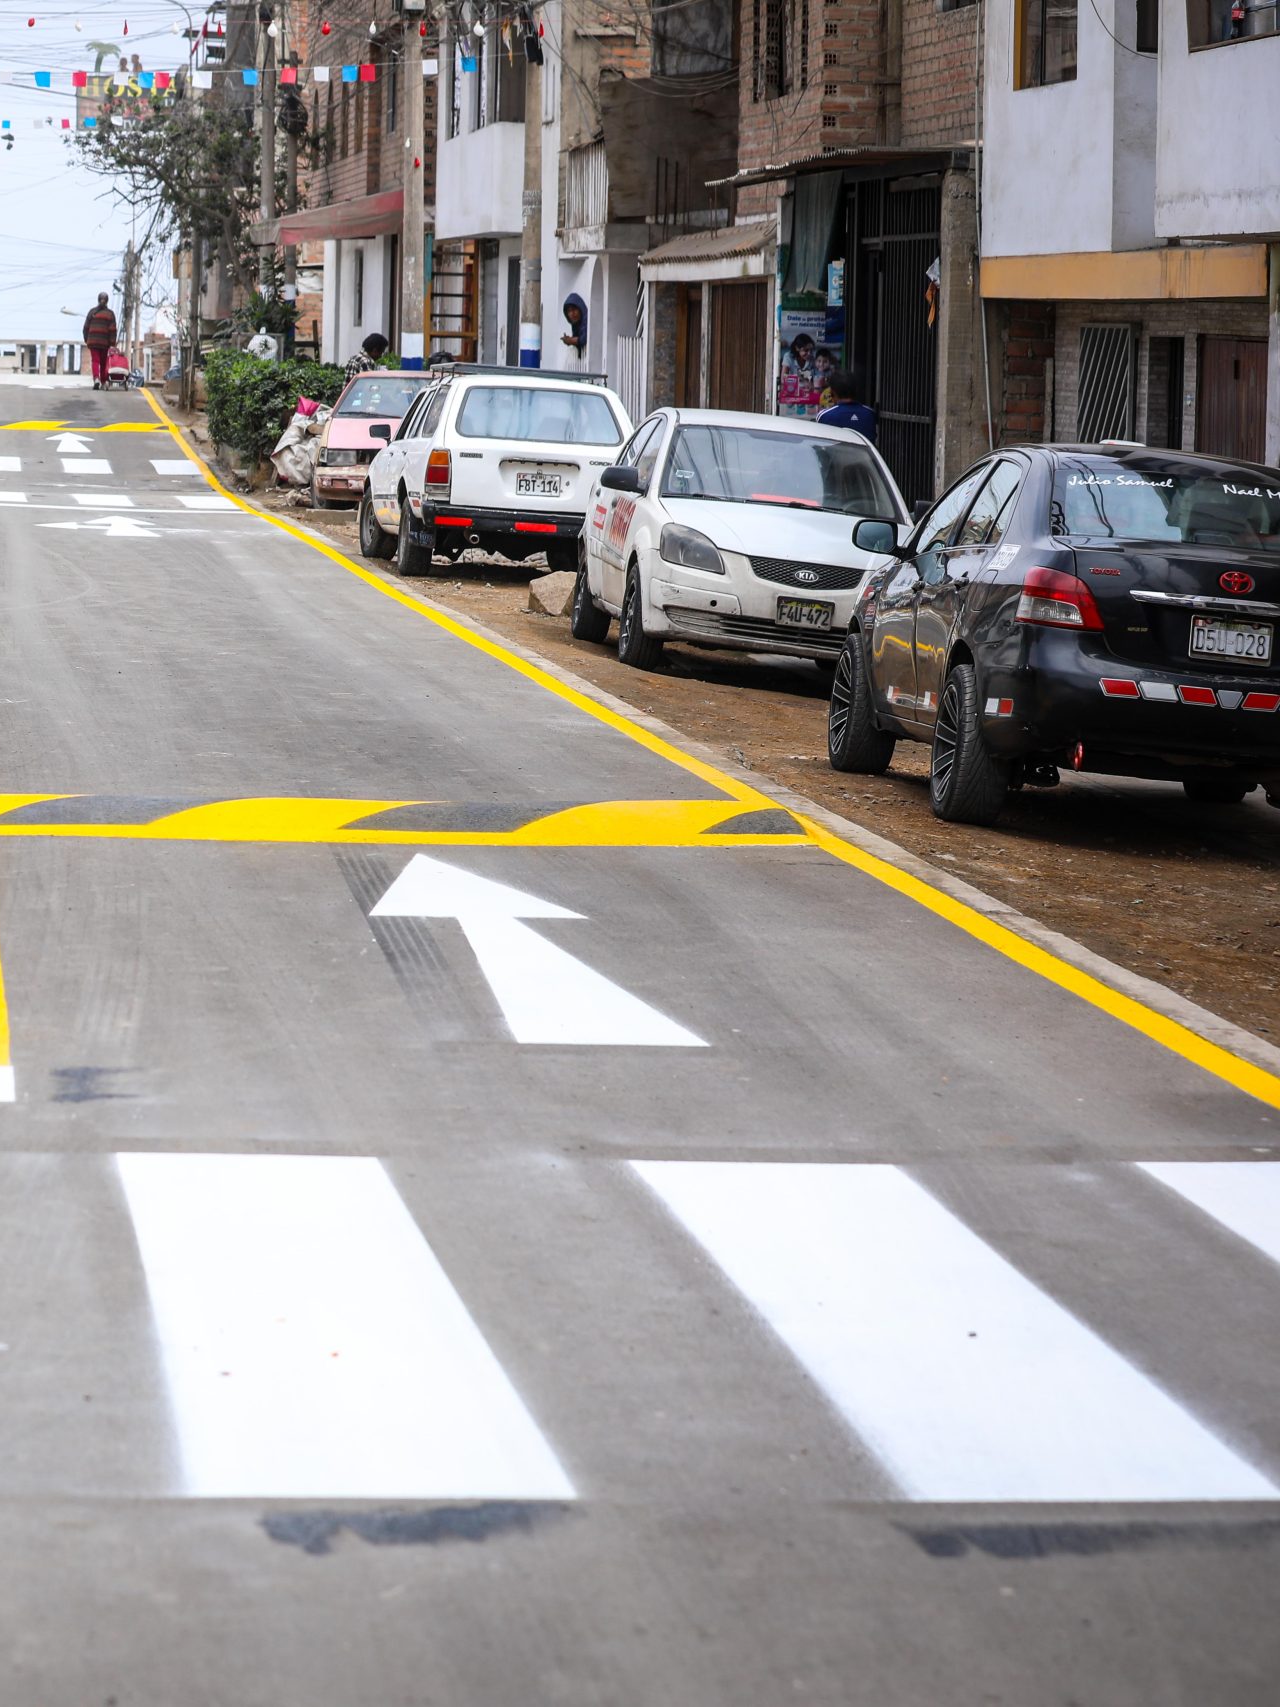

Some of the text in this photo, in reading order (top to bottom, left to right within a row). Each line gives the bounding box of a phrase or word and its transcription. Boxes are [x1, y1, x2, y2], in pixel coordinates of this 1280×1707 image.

[81, 77, 192, 98] HOSA
[1068, 475, 1174, 488] Julio Samuel
[1223, 484, 1263, 497] Nael
[799, 572, 815, 580] KIA
[780, 604, 830, 626] F4U-472
[1195, 627, 1266, 657] D5U-028
